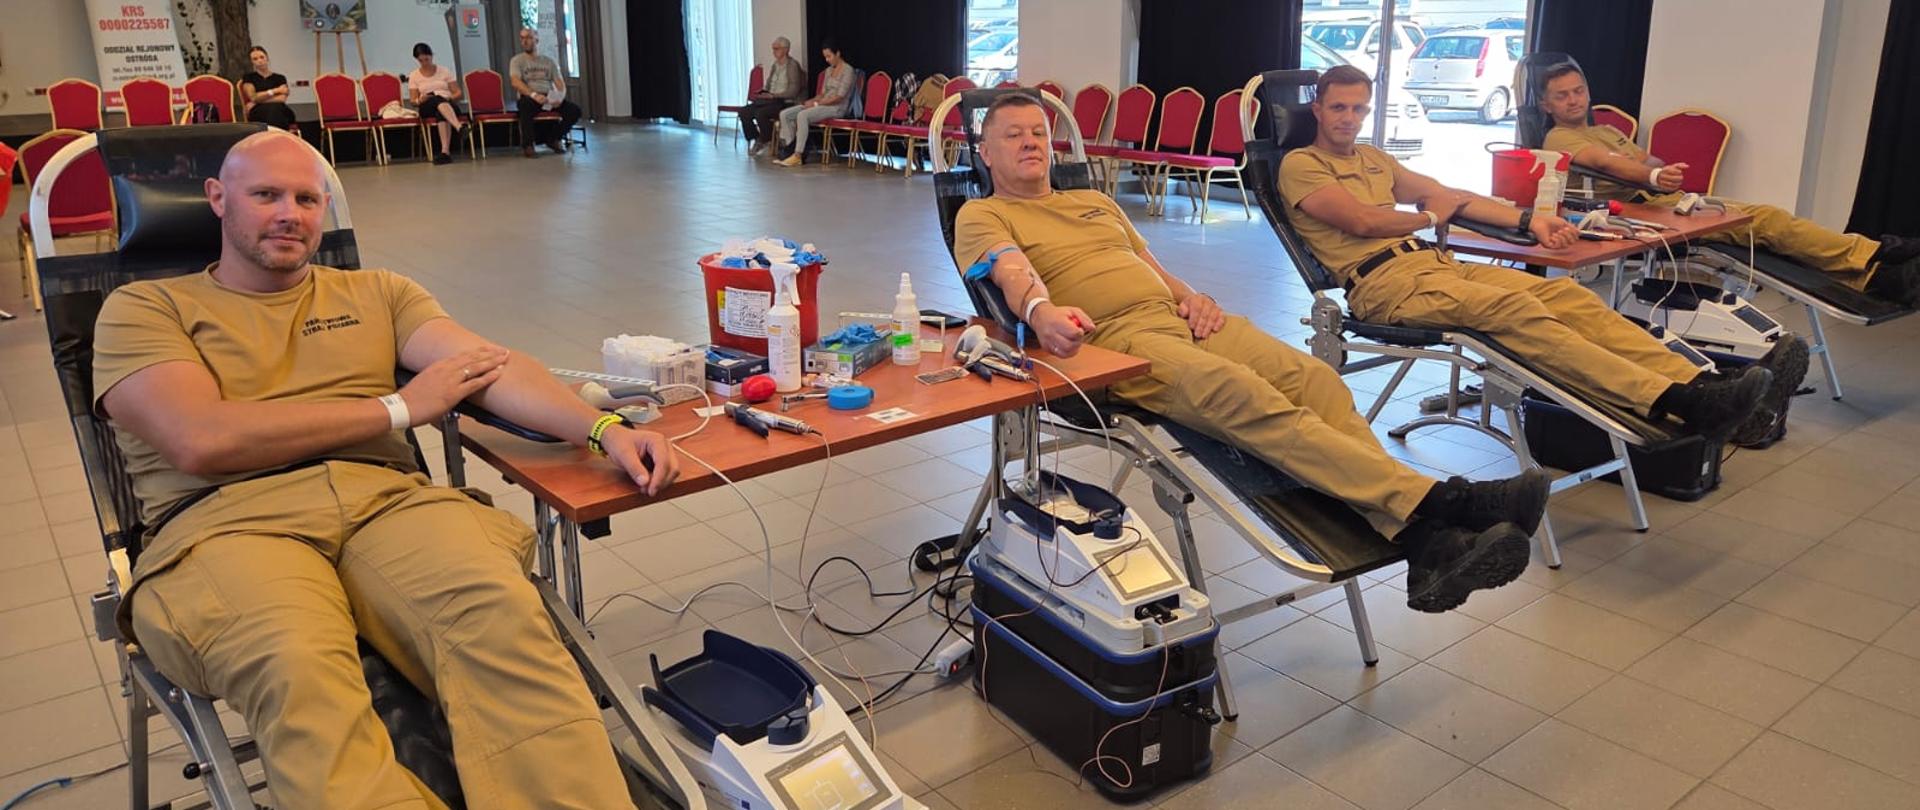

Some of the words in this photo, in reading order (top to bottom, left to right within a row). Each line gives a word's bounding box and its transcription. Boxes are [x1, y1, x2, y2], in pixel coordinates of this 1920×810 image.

[121, 6, 145, 17] KRS
[99, 18, 170, 31] 0000225587
[104, 46, 135, 54] ODDZIAŁ
[136, 45, 175, 53] REJONOWY
[125, 54, 159, 63] OSTRÓDA
